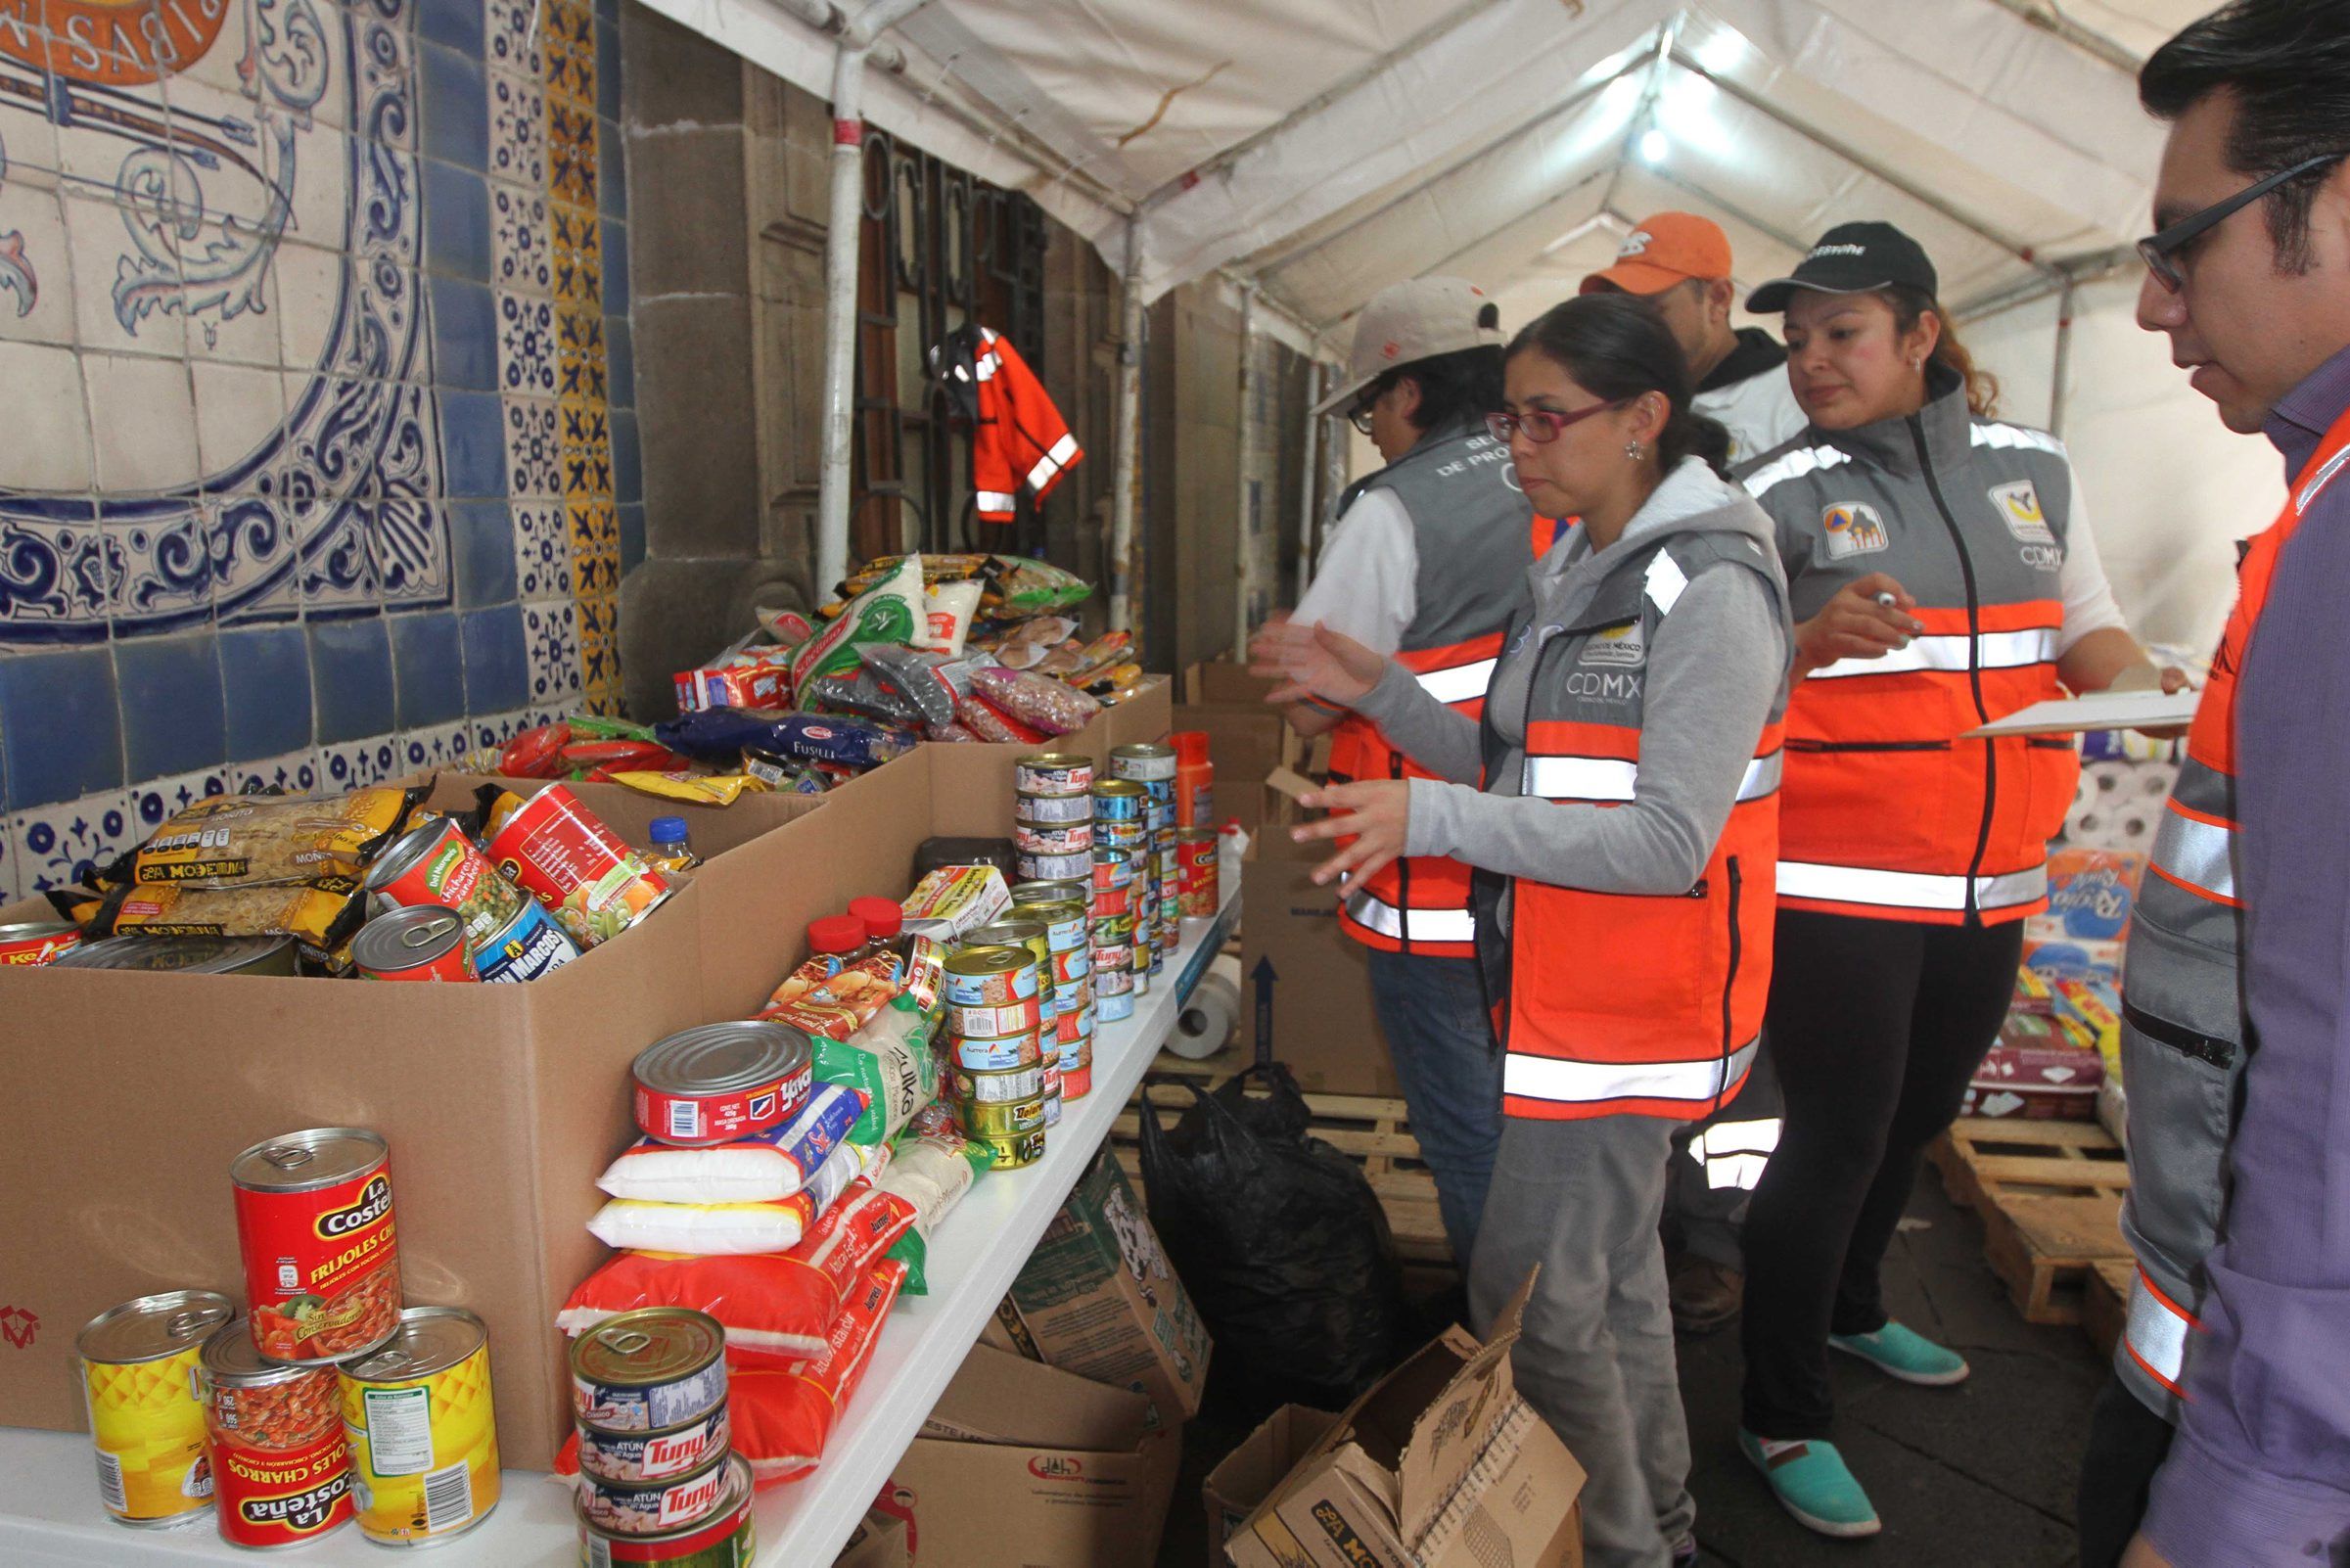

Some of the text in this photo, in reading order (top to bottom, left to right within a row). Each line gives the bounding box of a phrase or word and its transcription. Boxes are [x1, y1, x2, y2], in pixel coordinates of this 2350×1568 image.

[1436, 446, 1511, 477] DE PRO
[2019, 546, 2062, 566] CDMX
[1566, 672, 1641, 699] CDMX
[510, 929, 563, 978] MARCOS
[888, 1046, 918, 1117] Zulka
[368, 1180, 386, 1201] La
[309, 1234, 379, 1286] FRIJOLES
[307, 1310, 326, 1322] Sin
[617, 1441, 644, 1452] ATÚN
[649, 1433, 707, 1465] Tuny
[227, 1457, 309, 1485] CHARROS
[632, 1493, 661, 1503] ATÚN
[666, 1479, 717, 1513] Tuny
[294, 1506, 325, 1526] La
